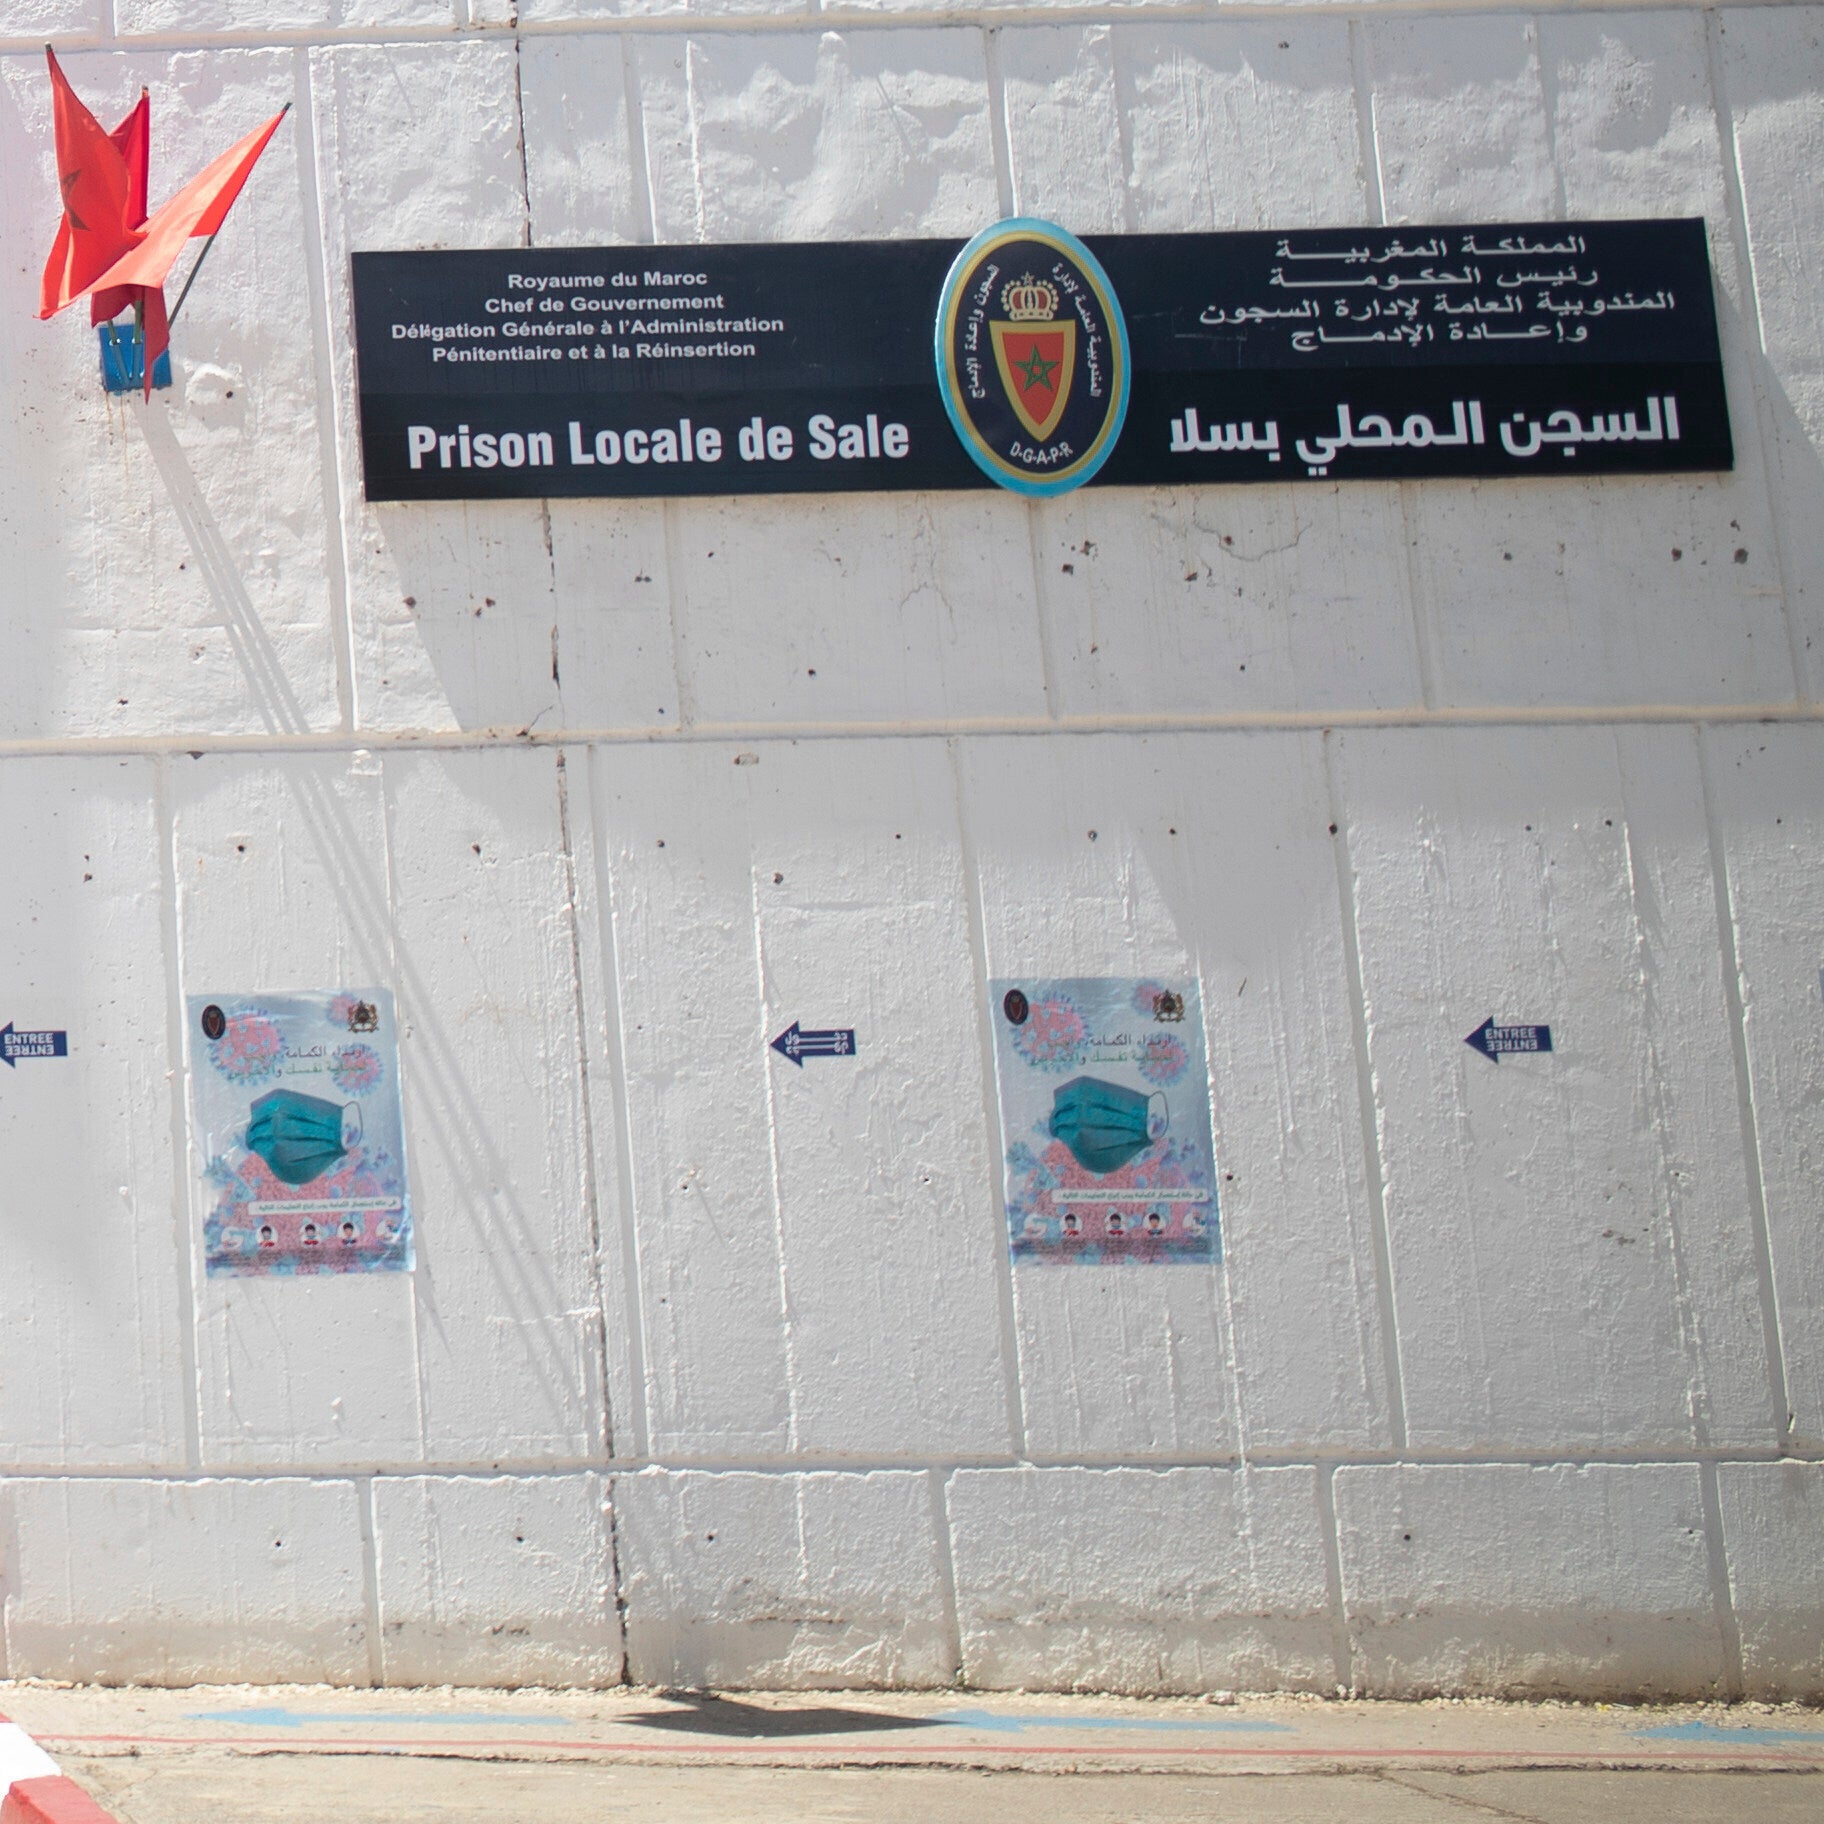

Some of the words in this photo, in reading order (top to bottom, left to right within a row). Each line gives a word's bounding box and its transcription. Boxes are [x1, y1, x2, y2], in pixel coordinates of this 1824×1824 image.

[1276, 239, 1447, 263] المغربية
[1461, 235, 1586, 256] المملكة
[507, 273, 606, 291] Royaume
[611, 271, 638, 287] du
[644, 270, 708, 287] Maroc
[1269, 266, 1481, 291] الحكومة
[1497, 265, 1598, 287] رئيس
[484, 297, 534, 314] Chef
[538, 297, 565, 313] de
[570, 294, 725, 312] Gouvernement
[1199, 298, 1320, 325] السجون
[1335, 297, 1420, 321] لإدارة
[1434, 294, 1523, 314] العامة
[1536, 291, 1675, 316] المندوبية
[391, 322, 496, 342] Délégation
[501, 320, 595, 337] Générale
[600, 319, 613, 335] à
[618, 316, 784, 335] l’Administration
[1290, 323, 1434, 351] الإدماج
[1449, 321, 1588, 343] وإعادة
[432, 344, 563, 363] Pénitentiaire
[567, 344, 589, 360] et
[593, 343, 606, 360] à
[611, 343, 630, 359] la
[636, 341, 756, 358] Réinsertion
[1170, 407, 1281, 462] بسلا
[1295, 400, 1485, 476] المحلي
[1499, 396, 1680, 456] السجن
[407, 424, 554, 469] Prison
[568, 418, 722, 465] Locale
[738, 416, 794, 462] de
[808, 414, 910, 460] Sale
[4, 1033, 54, 1044] ENTREE
[1485, 1027, 1536, 1039] ENTREE
